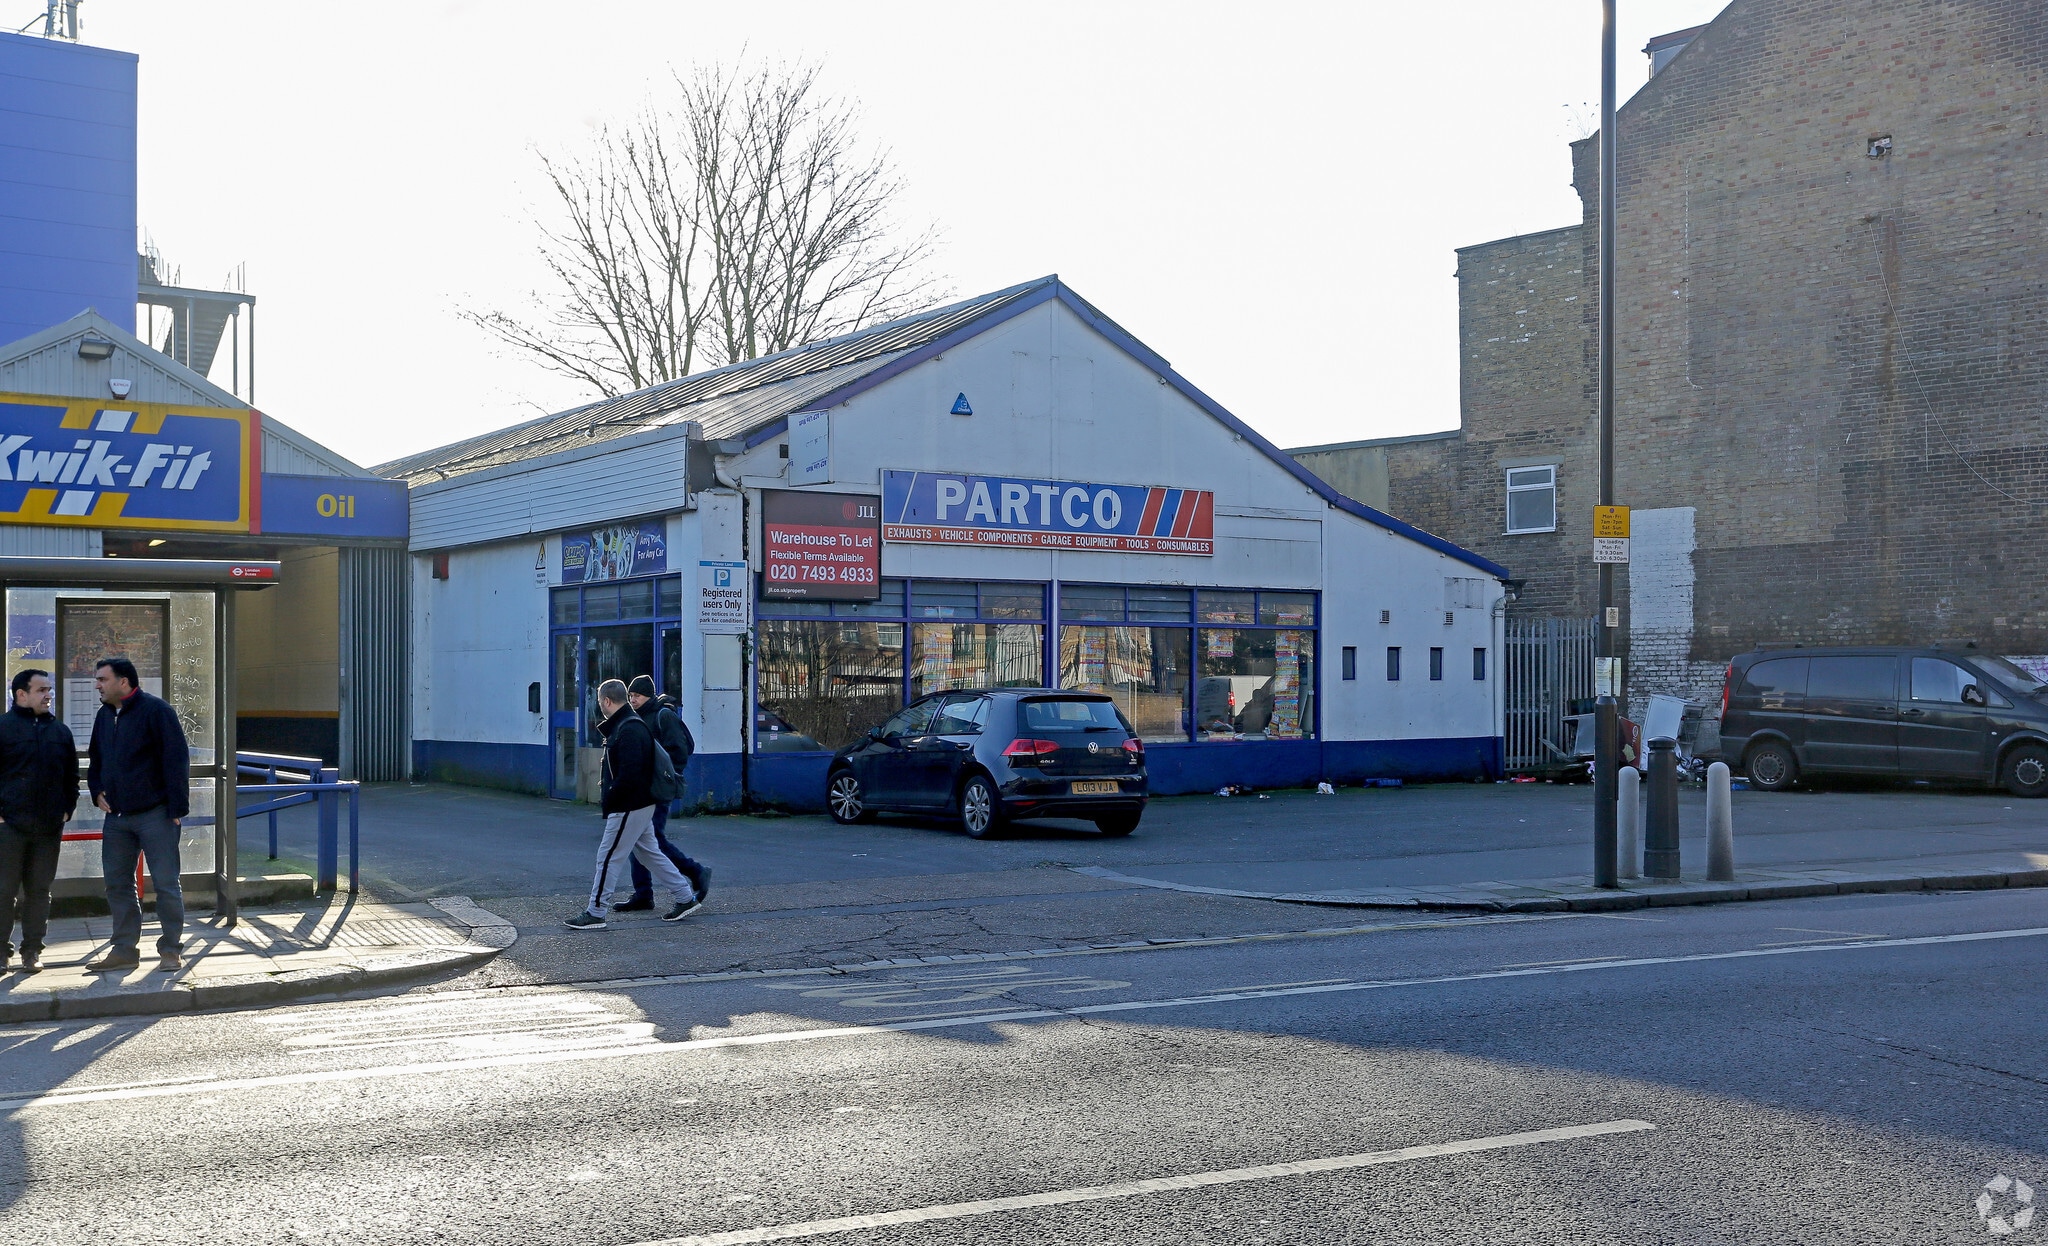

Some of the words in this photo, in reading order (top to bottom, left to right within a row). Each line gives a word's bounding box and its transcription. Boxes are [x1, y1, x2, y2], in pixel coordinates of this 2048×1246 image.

[0, 434, 212, 490] Kwik-Fit
[316, 493, 355, 518] Oil
[936, 479, 1122, 530] PARTCO
[856, 505, 877, 519] JLL
[640, 536, 651, 547] Any
[770, 530, 837, 546] Warehouse
[838, 533, 853, 547] To
[855, 534, 873, 548] Let
[887, 527, 932, 539] EXHAUSTS
[939, 529, 973, 541] VEHICLE
[977, 531, 1033, 544] COMPONENTS
[1041, 534, 1072, 546] GARAGE
[1075, 536, 1118, 548] EQUIPMENT
[1125, 538, 1149, 550] TOOLS
[1156, 540, 1210, 552] CONSUMABLES
[637, 550, 646, 560] For
[646, 549, 655, 560] Any
[655, 547, 664, 558] Car
[770, 550, 802, 560] Flexible
[803, 551, 827, 561] Terms
[828, 552, 864, 563] Available
[716, 569, 729, 586] P
[770, 564, 797, 580] 020
[801, 565, 836, 581] 7493
[840, 566, 874, 582] 4933
[702, 587, 742, 600] Registered
[767, 587, 807, 595] jll.co.uk/property
[703, 600, 723, 609] users
[724, 599, 742, 611] Only
[1097, 782, 1114, 791] VJA
